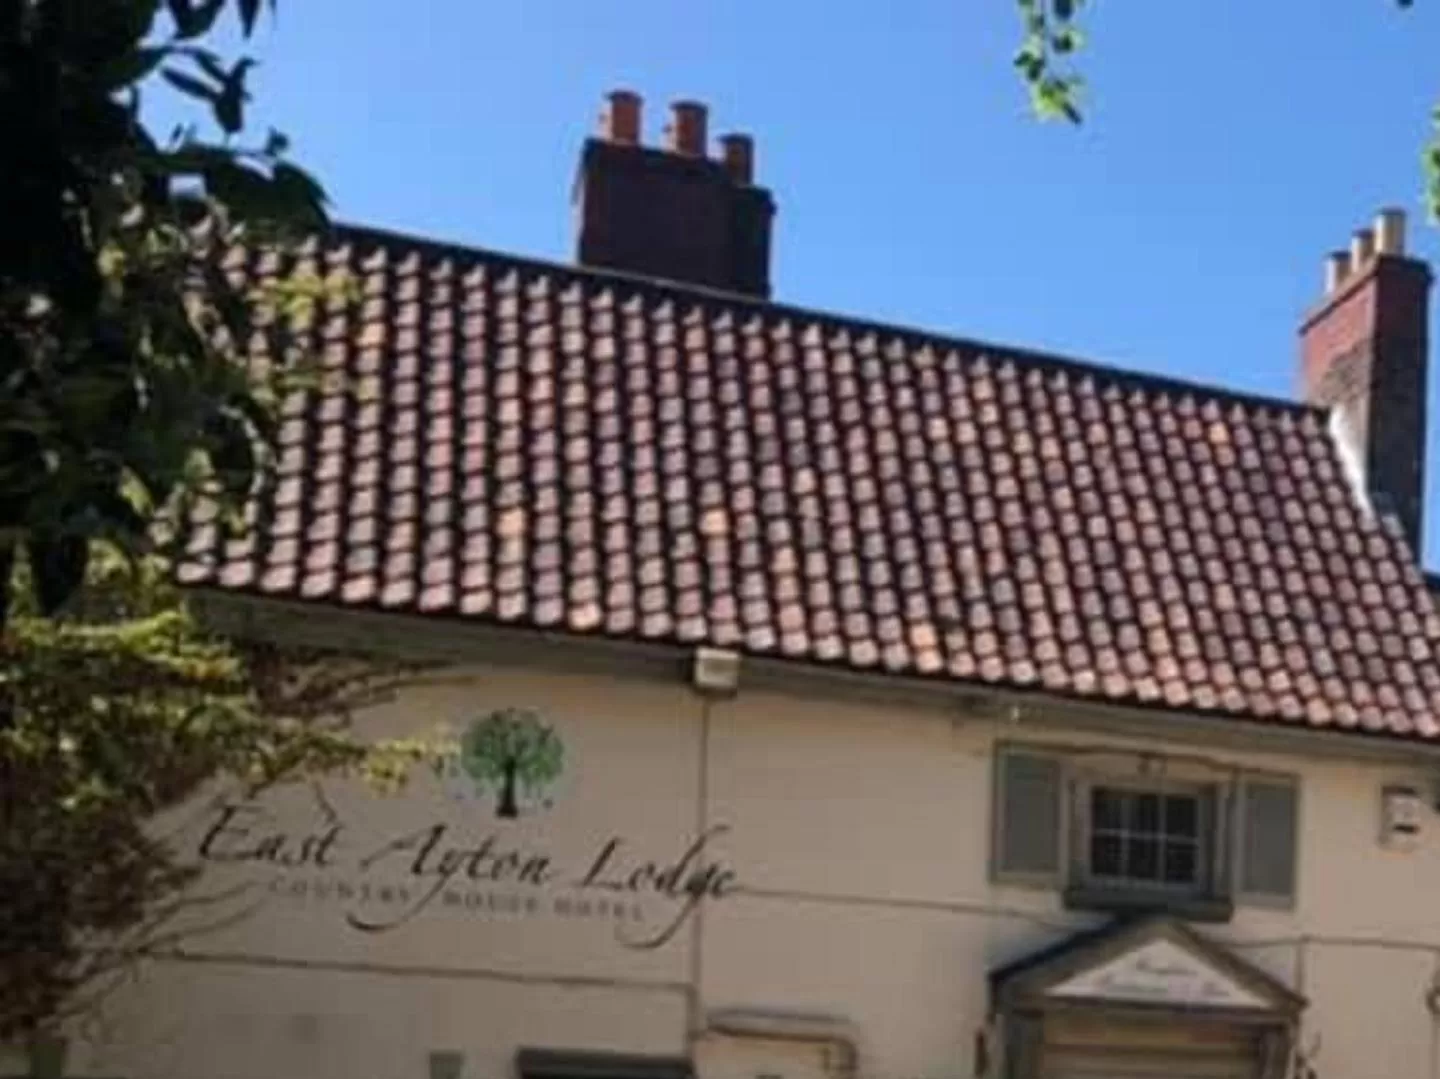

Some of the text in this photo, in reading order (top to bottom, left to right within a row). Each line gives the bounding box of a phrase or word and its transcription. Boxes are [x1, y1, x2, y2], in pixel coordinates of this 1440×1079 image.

[199, 803, 737, 950] East Ayton Lodge
